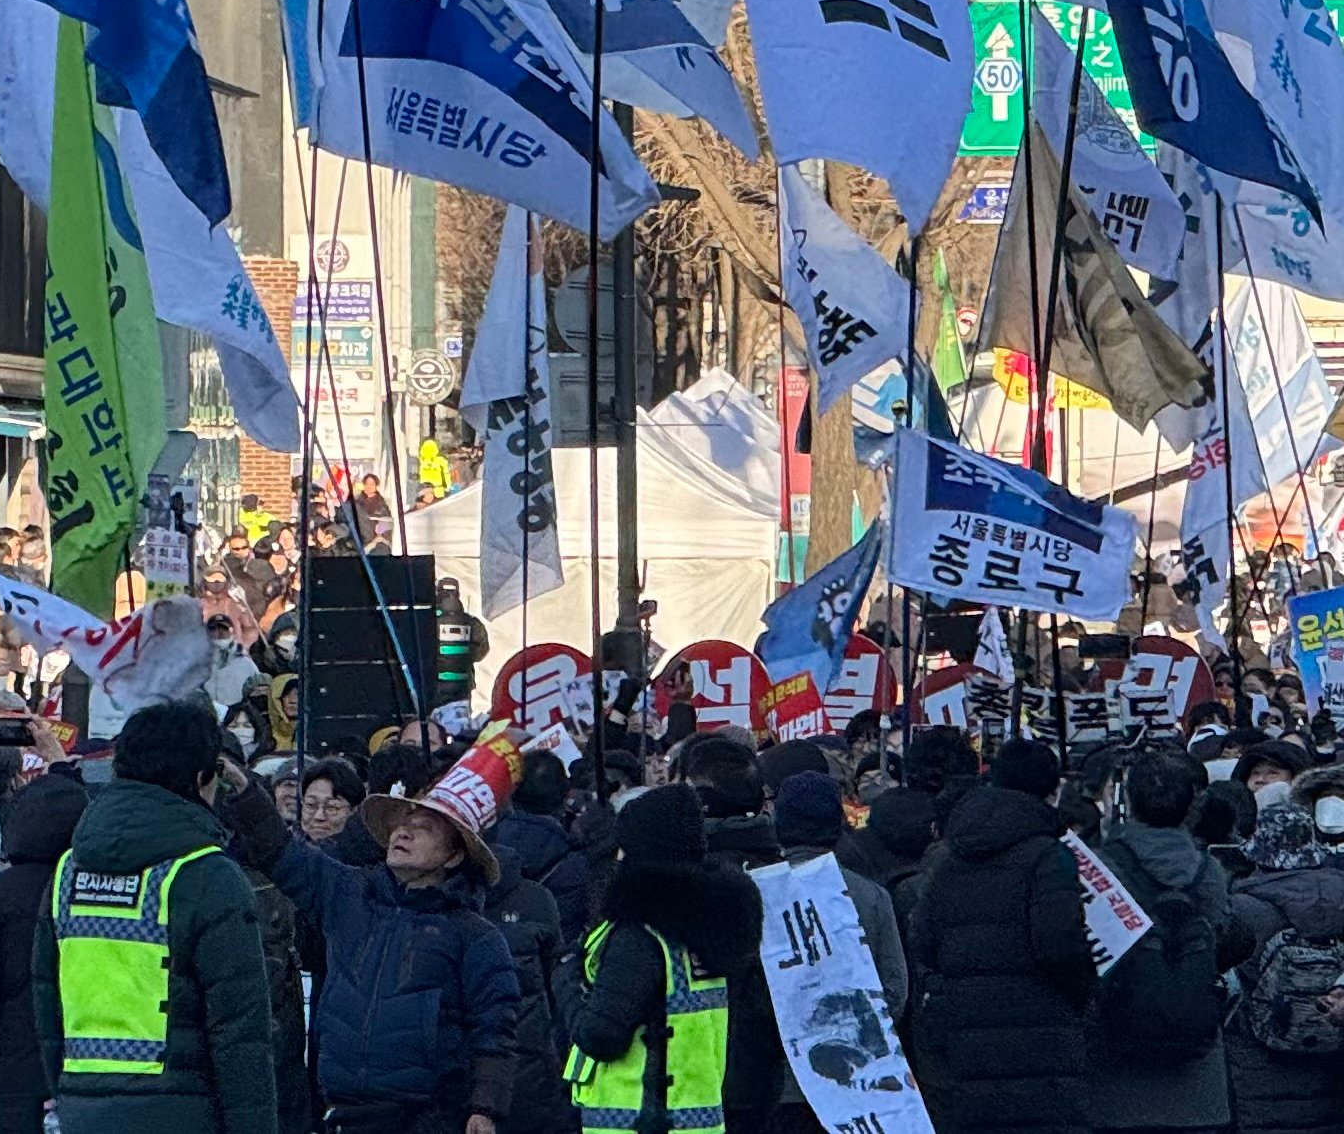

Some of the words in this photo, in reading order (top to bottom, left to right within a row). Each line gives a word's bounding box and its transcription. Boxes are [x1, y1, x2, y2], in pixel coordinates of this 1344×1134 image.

[986, 65, 1013, 88] 50
[951, 513, 1074, 563] 서울특별시당
[928, 533, 1085, 606] 종로구
